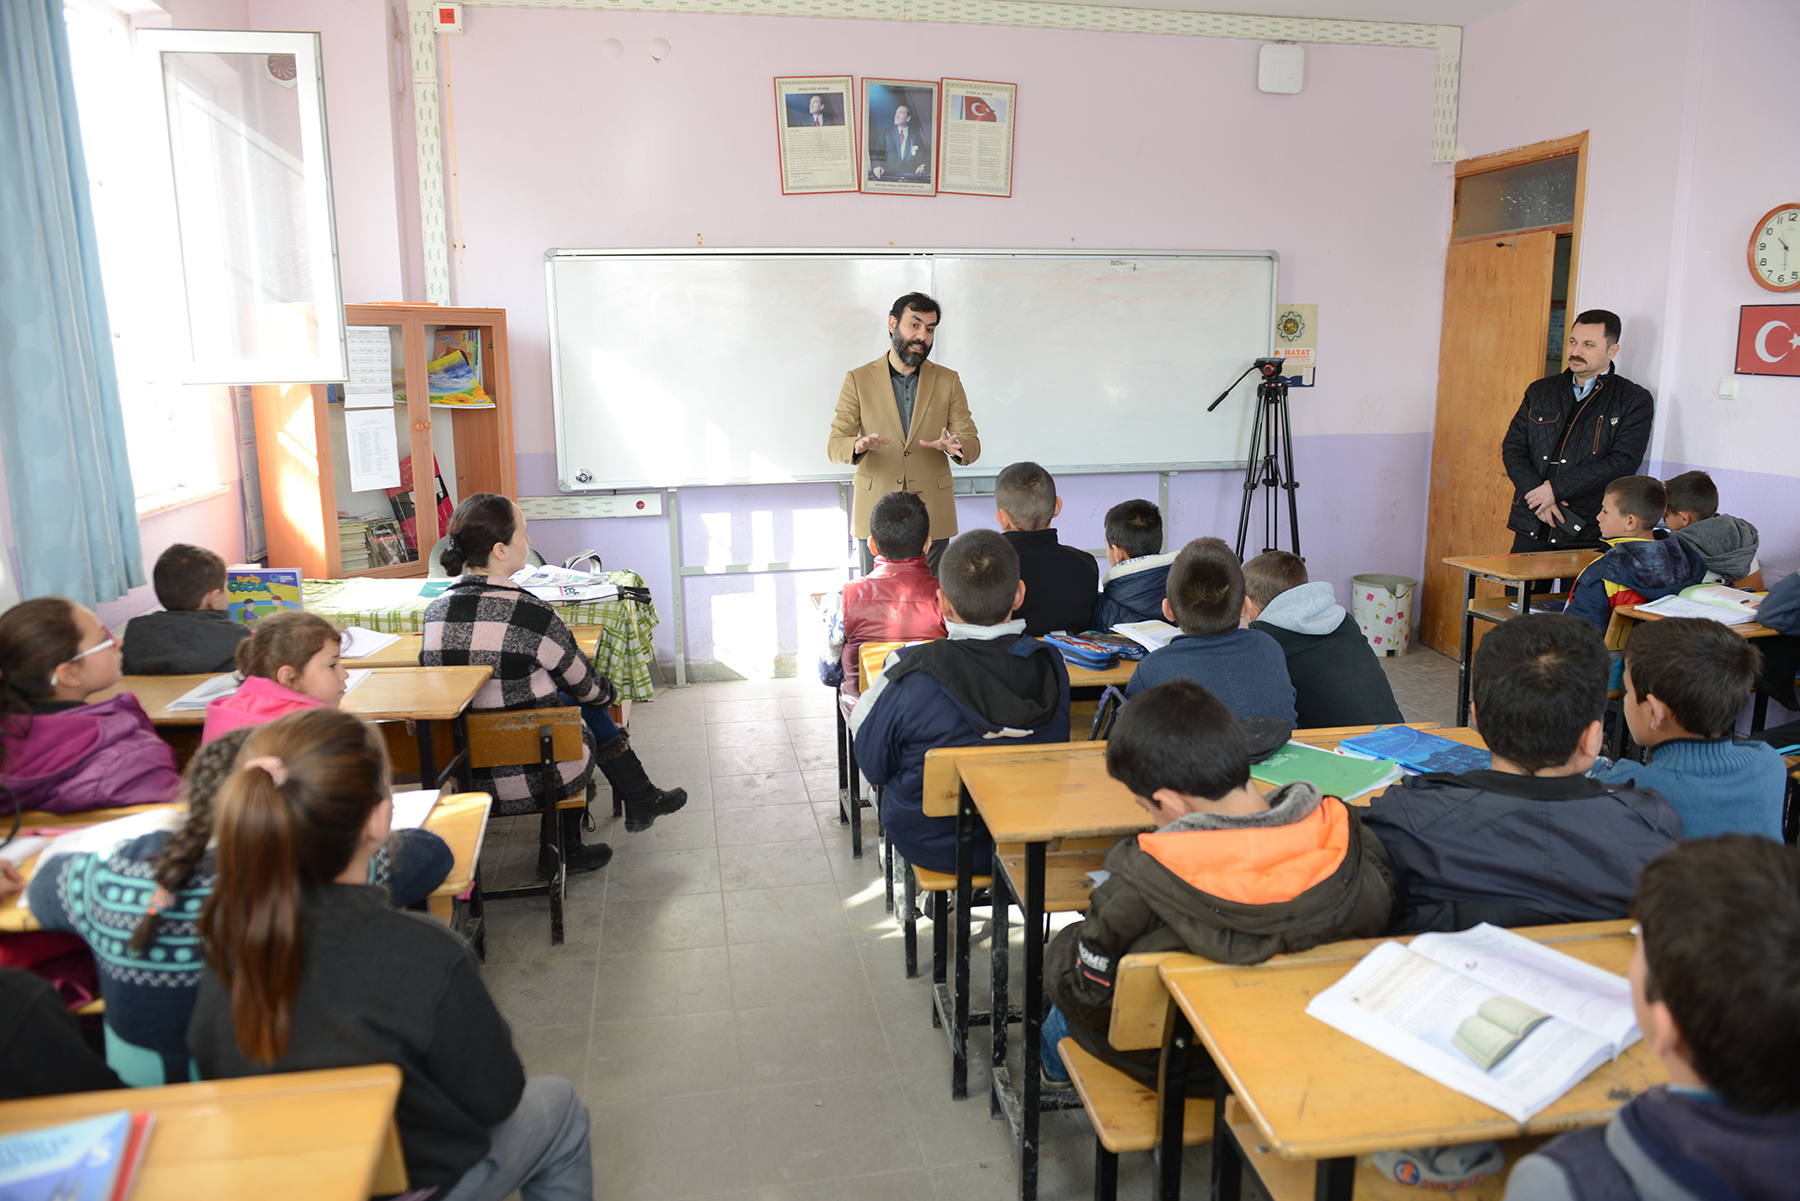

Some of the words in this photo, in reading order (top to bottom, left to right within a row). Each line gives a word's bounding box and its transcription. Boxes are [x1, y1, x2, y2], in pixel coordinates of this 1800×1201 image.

[1777, 216, 1784, 225] 11
[1788, 212, 1798, 222] 12
[1765, 227, 1774, 236] 10
[1759, 242, 1767, 251] 9
[1760, 258, 1767, 266] 8
[1767, 269, 1774, 279] 7
[1777, 274, 1785, 283] 6
[1790, 271, 1799, 280] 5
